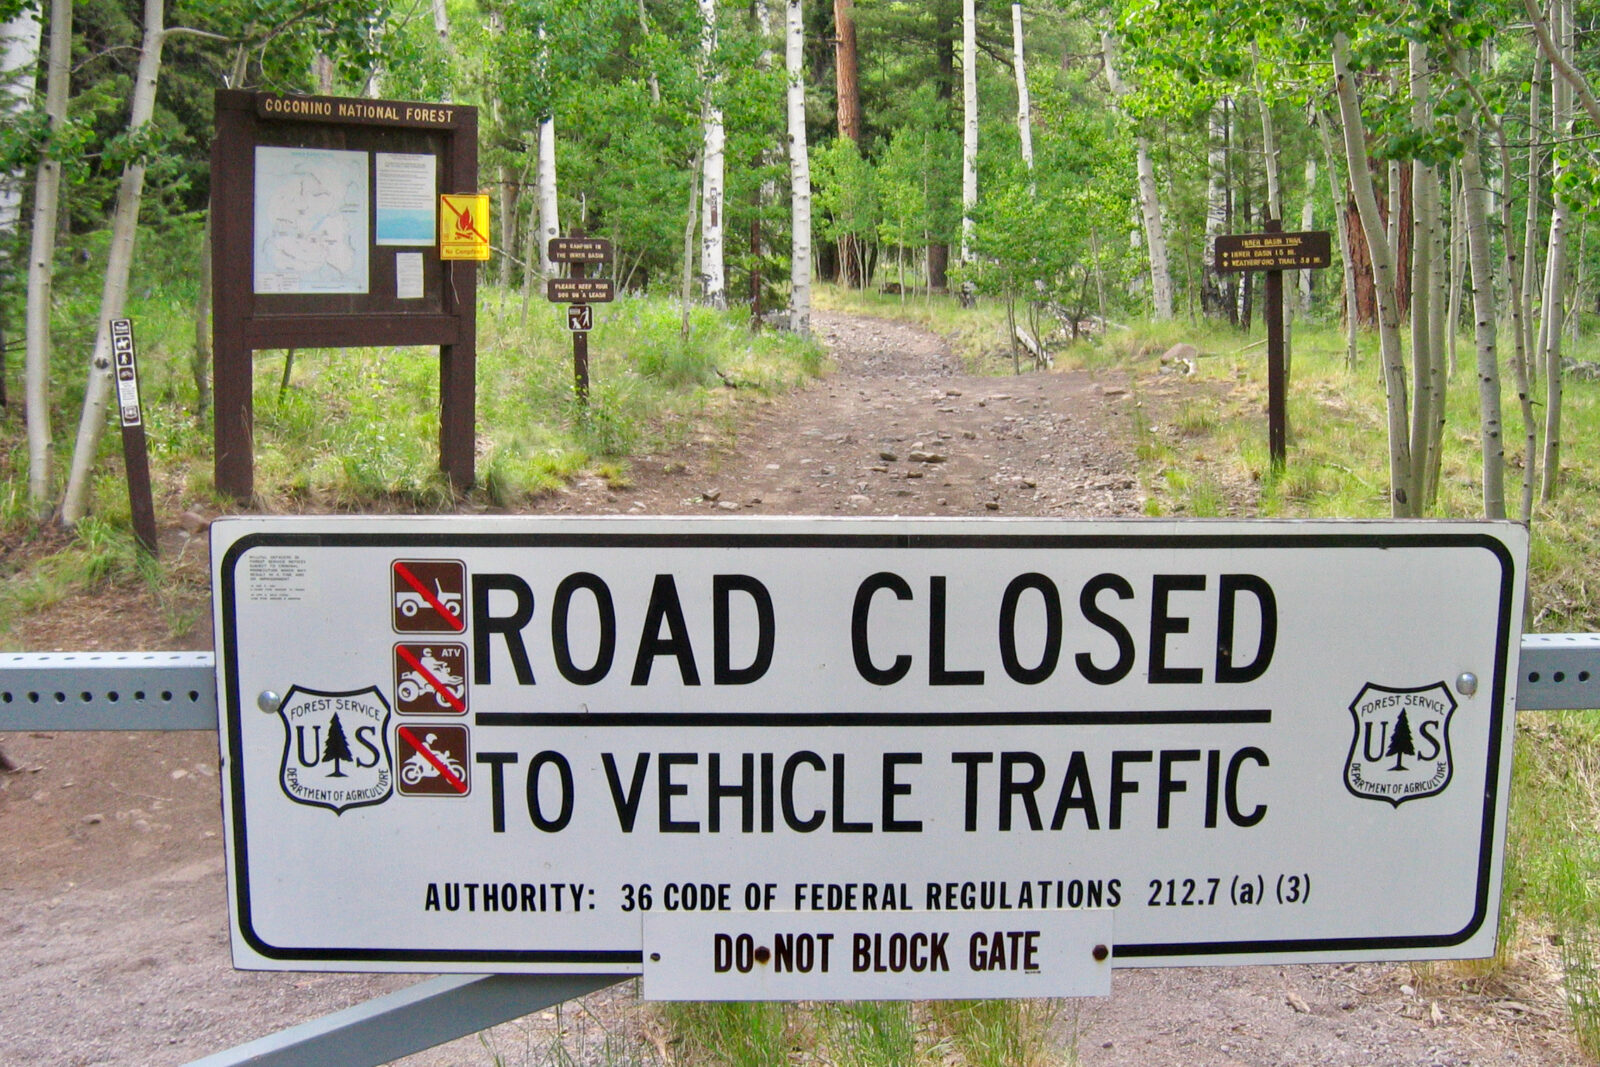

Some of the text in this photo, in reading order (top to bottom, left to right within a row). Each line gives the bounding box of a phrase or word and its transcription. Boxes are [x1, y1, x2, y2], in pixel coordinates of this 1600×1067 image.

[265, 98, 454, 123] COCONINO NATIONAL FOREST
[471, 571, 1278, 686] ROAD CLOSED
[441, 648, 461, 657] ATV
[290, 698, 380, 721] FOREST SERVICE
[1361, 694, 1445, 717] FOREST SERVICE
[286, 767, 389, 801] DEPARTMENT OF AGRICULTURE
[476, 746, 1270, 833] TO VEHICLE TRAFFIC
[1351, 761, 1447, 794] DEPARTMENT OF AGRICULTURE
[425, 873, 1311, 912] AUTHORITY: 36 CODE OF FEDERAL REGULATIONS 212.7 (a) (3)
[714, 930, 1041, 973] DO NOT BLOCK GATE
